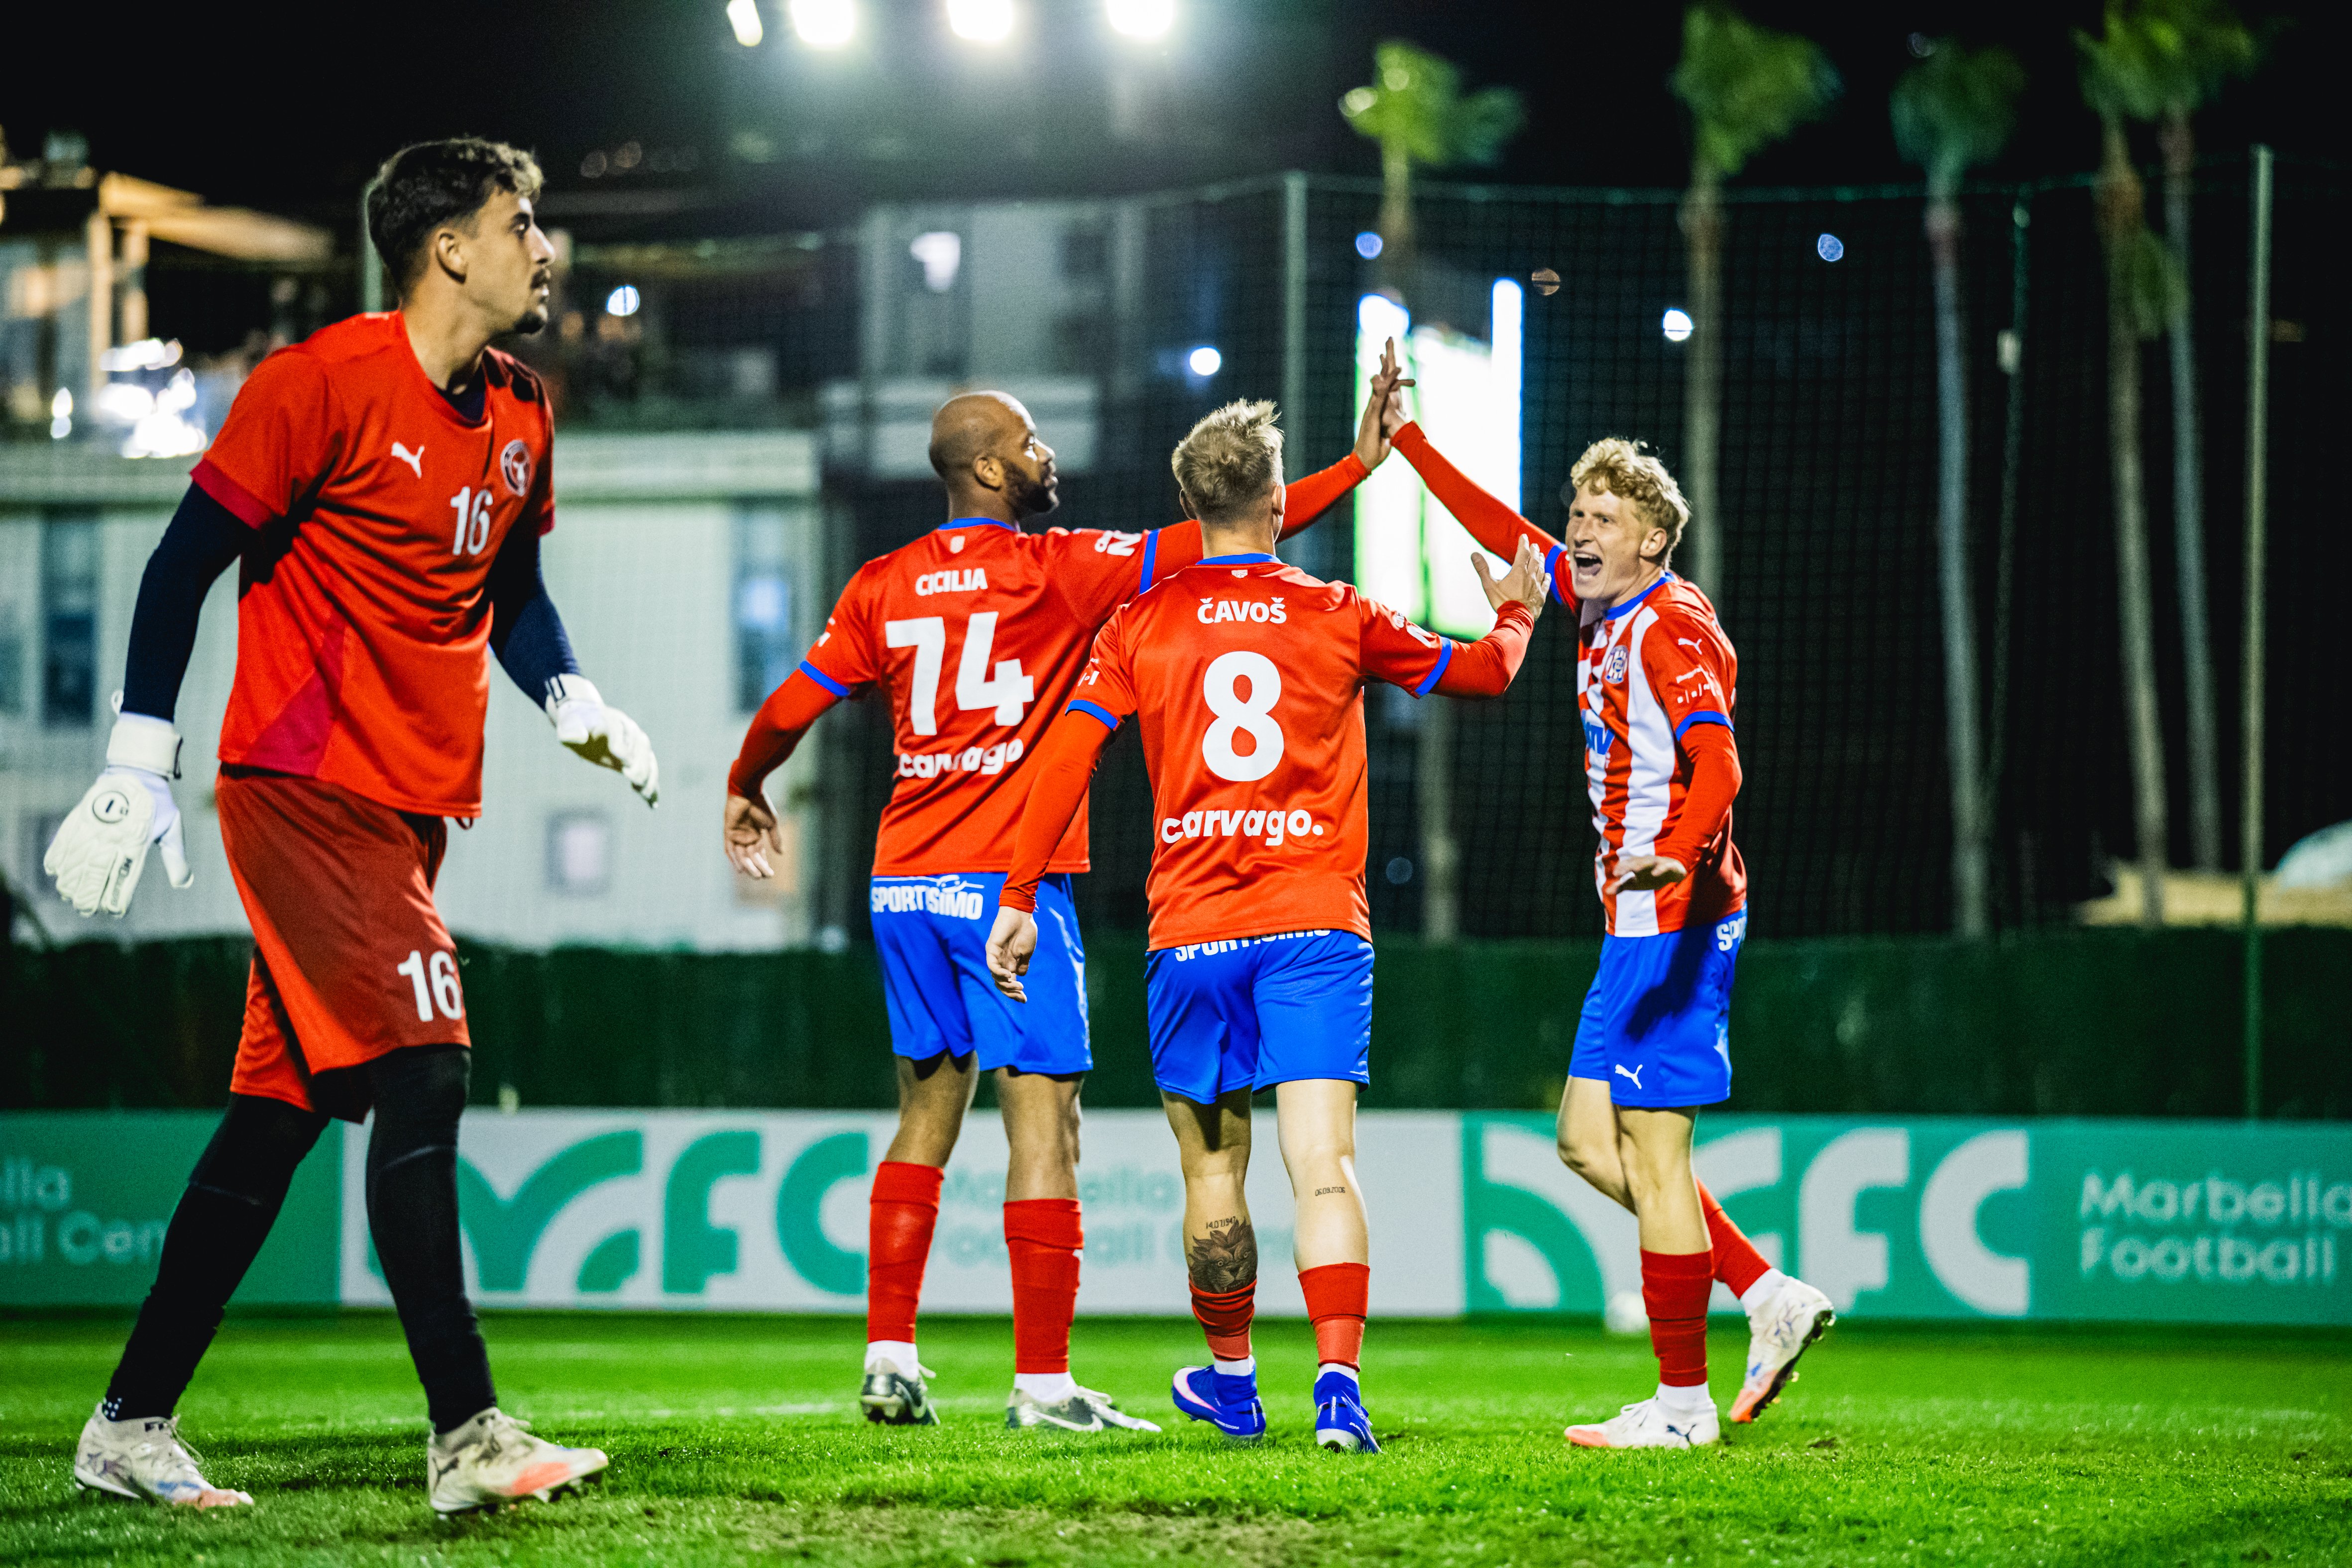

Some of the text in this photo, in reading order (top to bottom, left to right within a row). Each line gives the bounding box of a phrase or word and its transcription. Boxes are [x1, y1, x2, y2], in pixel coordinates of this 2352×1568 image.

[450, 486, 493, 555] 16
[915, 568, 988, 596] CICILIA
[1197, 597, 1287, 624] ČAVOŠ
[885, 611, 1034, 736] 74
[1202, 651, 1284, 782] 8
[397, 950, 462, 1022] 16
